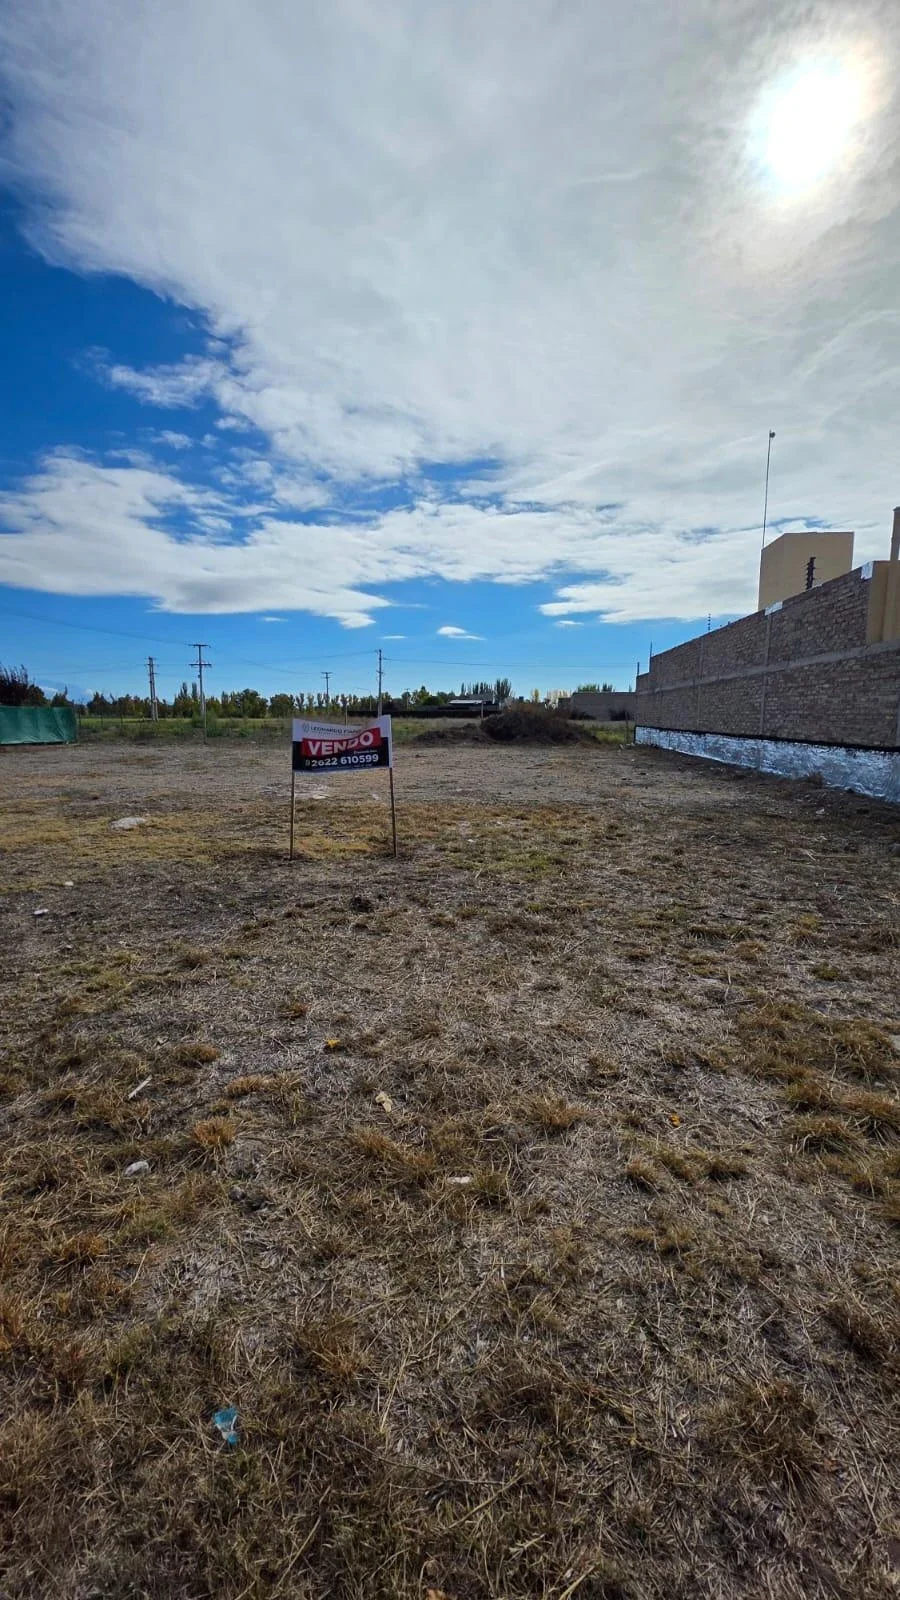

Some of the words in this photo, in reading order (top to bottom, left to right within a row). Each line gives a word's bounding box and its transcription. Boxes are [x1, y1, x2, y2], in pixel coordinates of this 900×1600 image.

[308, 732, 373, 756] VENDO
[311, 757, 338, 767] 2622
[340, 754, 379, 765] 610599
